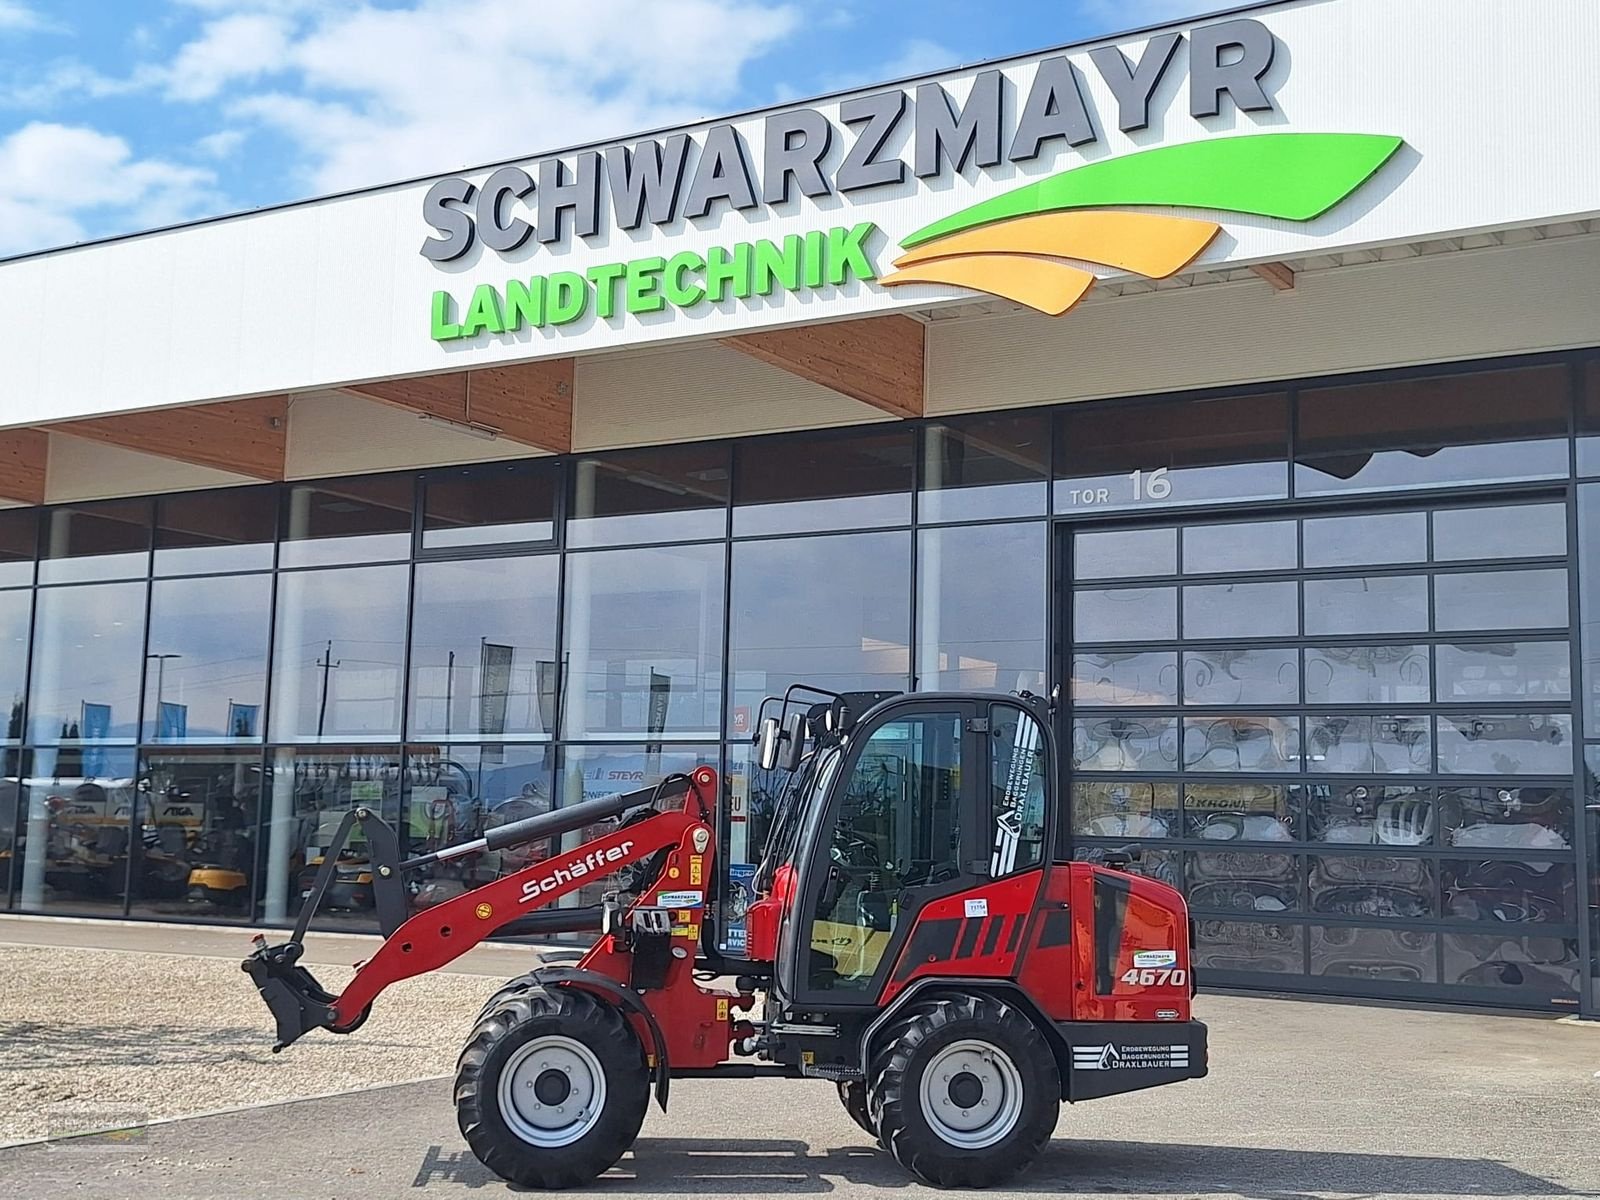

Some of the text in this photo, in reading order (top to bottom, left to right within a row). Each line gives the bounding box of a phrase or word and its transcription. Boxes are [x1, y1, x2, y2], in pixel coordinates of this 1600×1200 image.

[420, 17, 1277, 262] SCHWARZMAYR
[431, 222, 878, 342] LANDTECHNIK
[1069, 466, 1172, 504] TOR 16
[608, 770, 644, 780] STEYR
[518, 840, 635, 904] Schäffer
[1121, 969, 1186, 986] 4670
